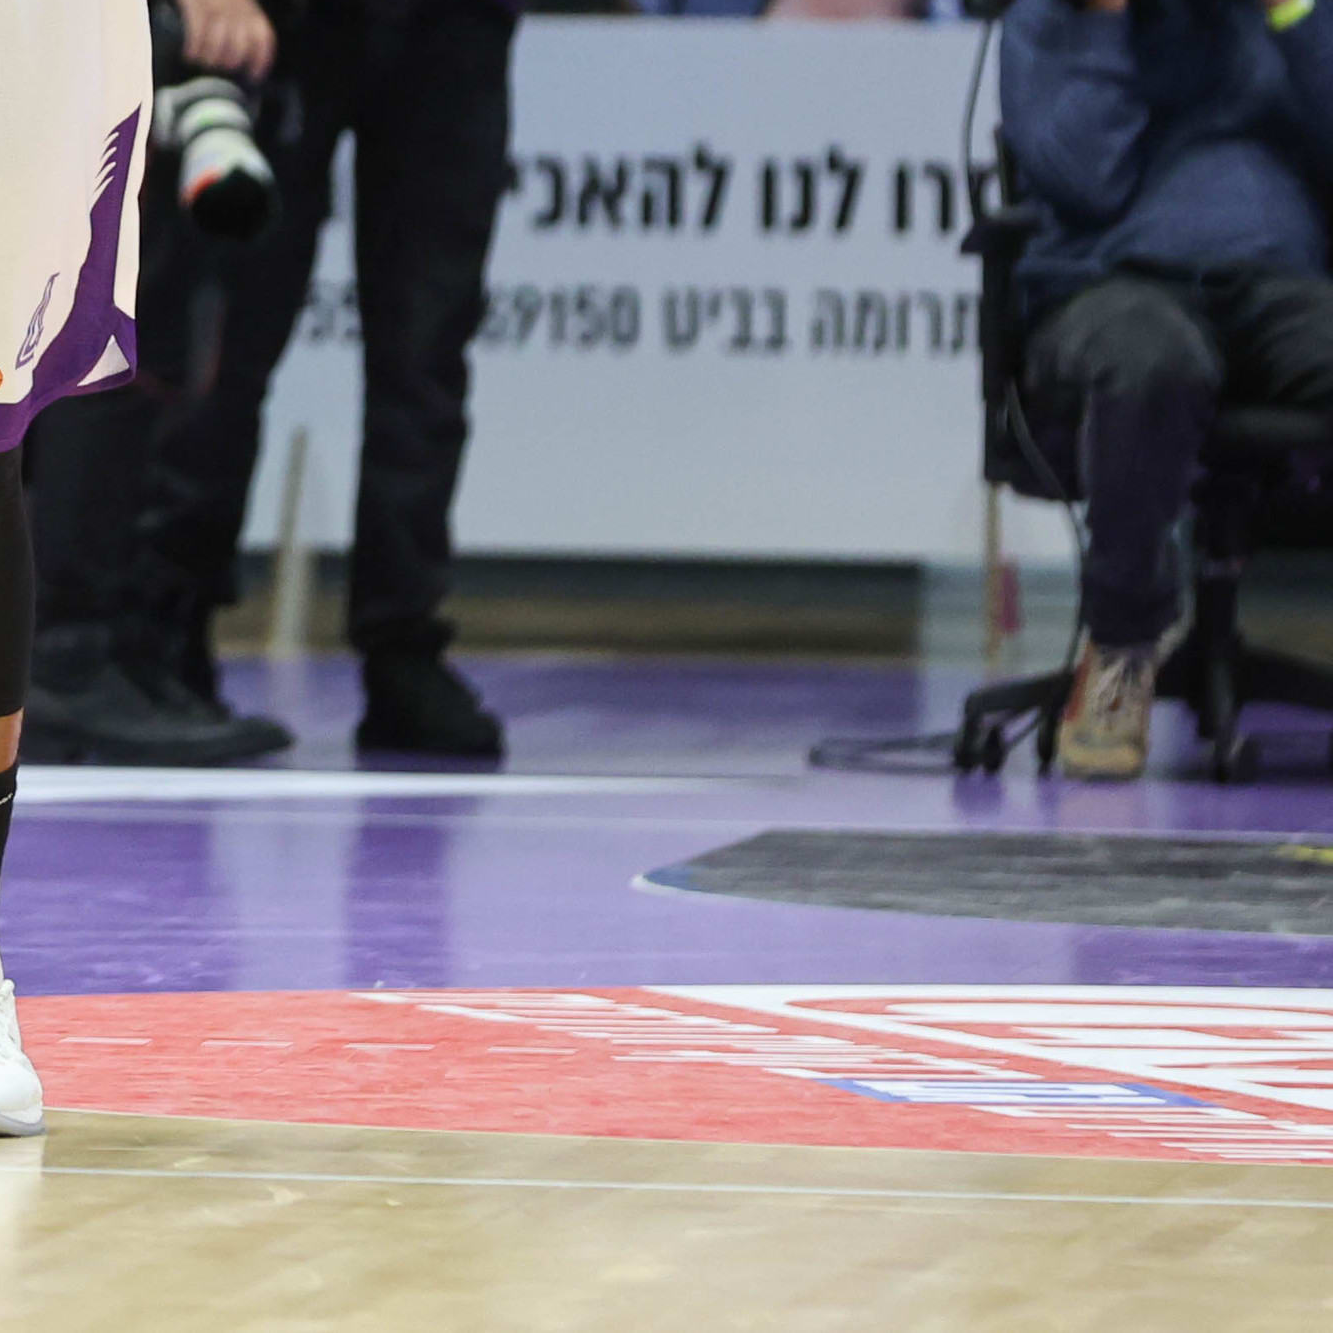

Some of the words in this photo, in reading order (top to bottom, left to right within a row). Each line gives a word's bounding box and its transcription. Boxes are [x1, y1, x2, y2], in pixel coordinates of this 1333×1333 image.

[505, 140, 732, 233] להאכי
[757, 144, 867, 233] לנו
[664, 286, 787, 351] בביט
